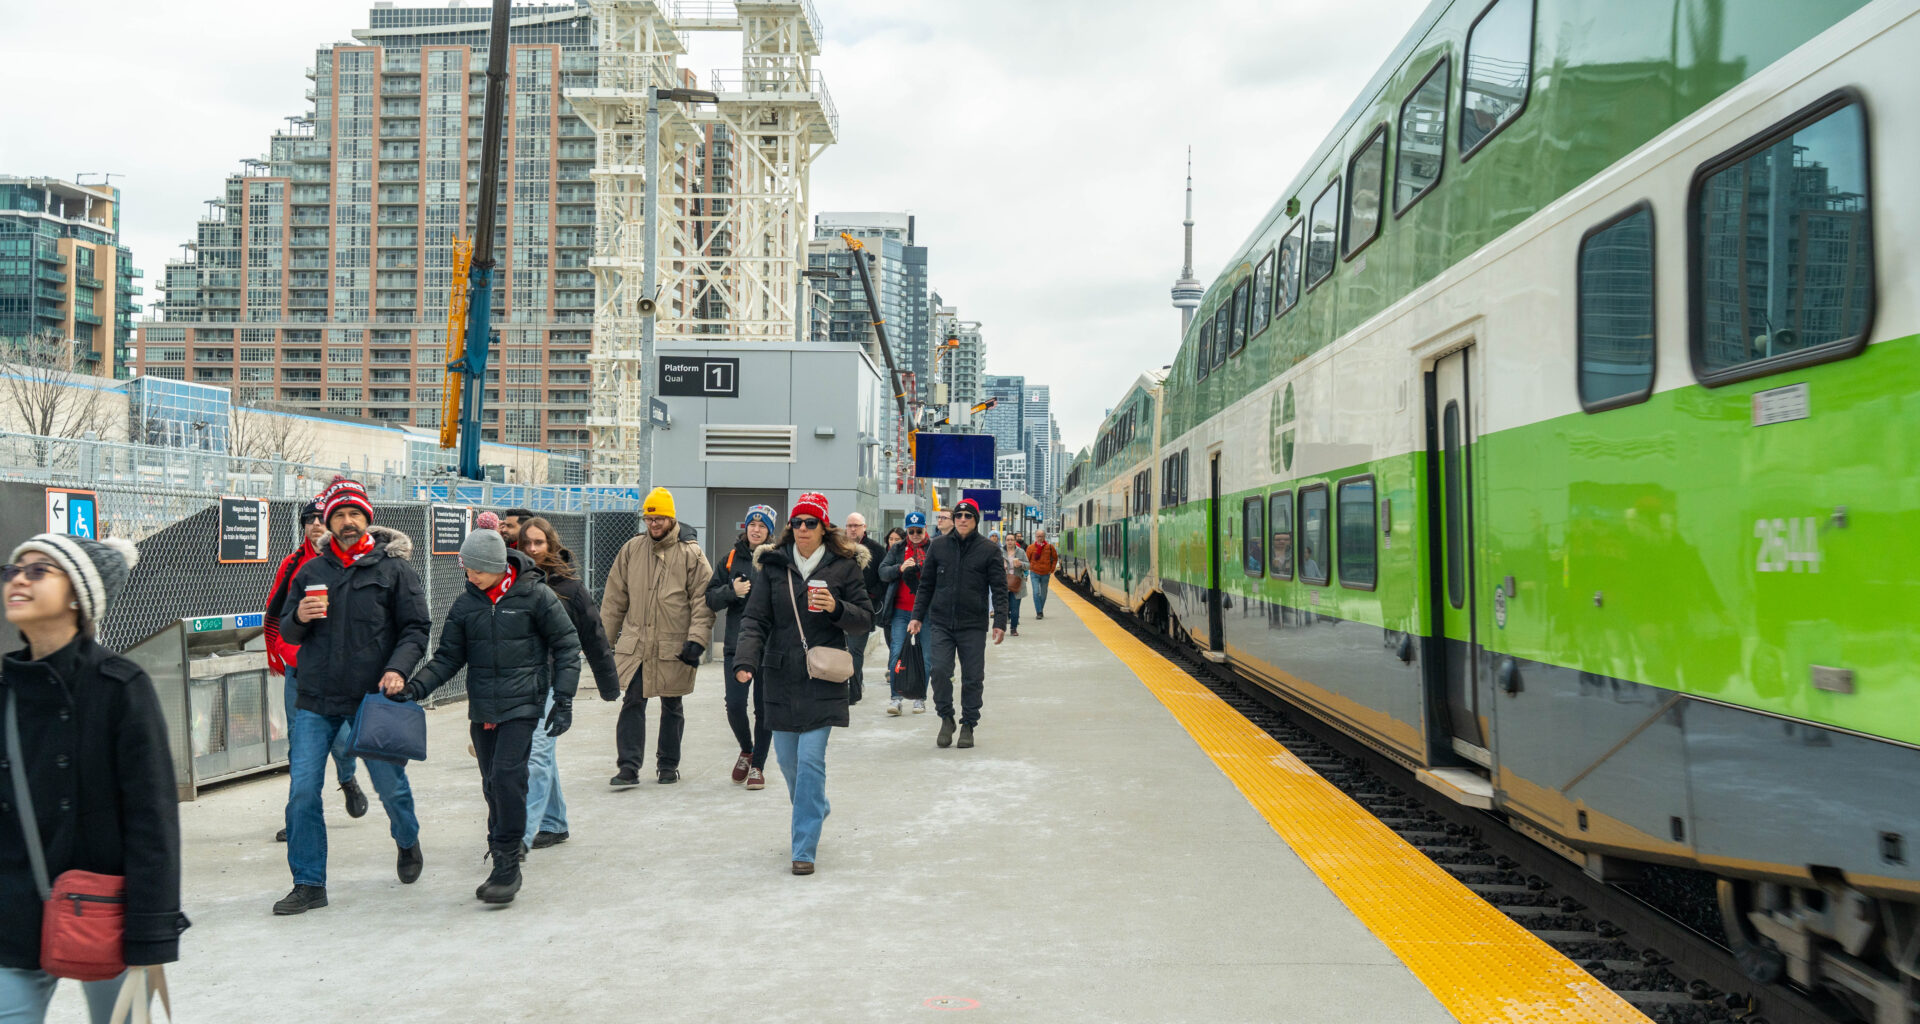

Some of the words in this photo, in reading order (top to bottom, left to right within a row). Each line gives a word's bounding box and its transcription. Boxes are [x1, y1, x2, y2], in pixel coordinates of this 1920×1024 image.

[664, 364, 699, 372] Platform
[712, 367, 722, 387] 1
[1754, 516, 1824, 574] 2644
